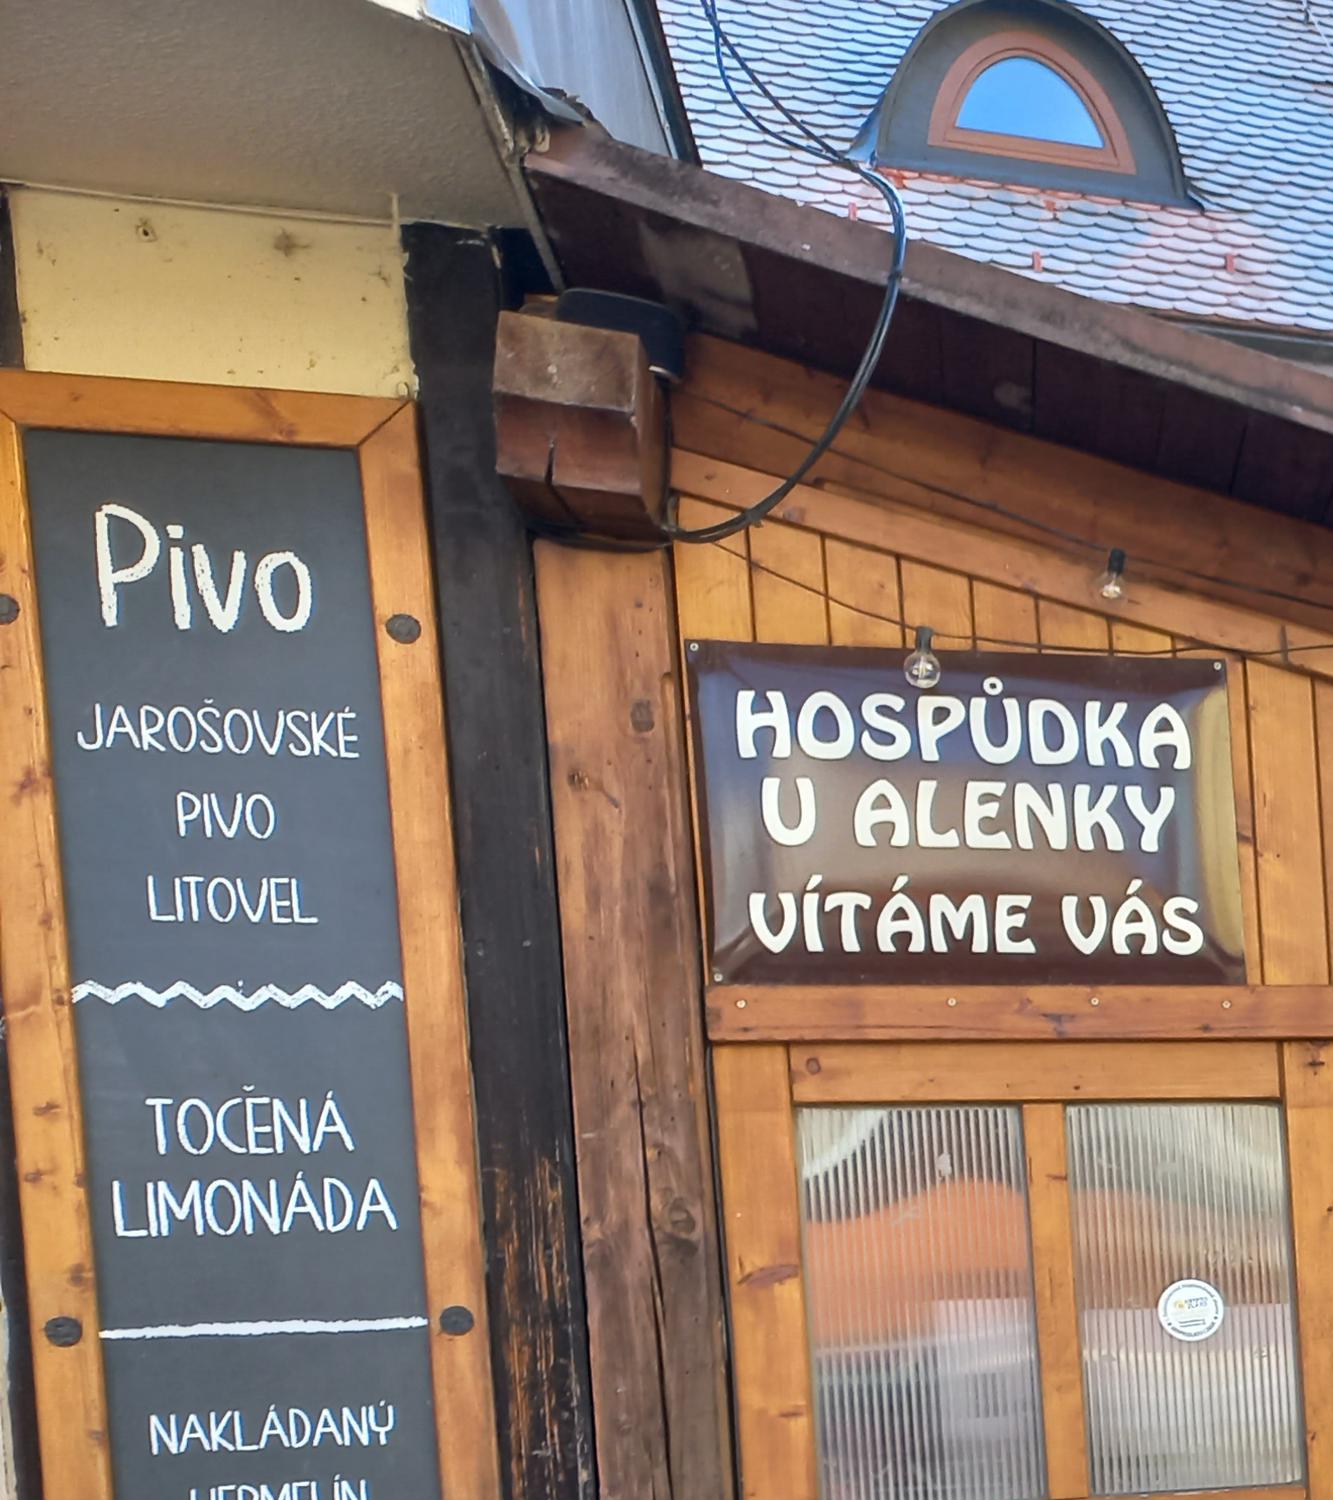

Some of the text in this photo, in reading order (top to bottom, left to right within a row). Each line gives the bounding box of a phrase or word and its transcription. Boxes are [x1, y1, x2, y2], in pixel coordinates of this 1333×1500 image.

[95, 503, 312, 632] Pivo
[77, 698, 360, 759] JAROŠOVSKÉ
[736, 676, 1192, 770] HOSPŮDKA
[176, 791, 275, 839] PIVO
[761, 777, 1176, 853] U ALENKY
[147, 874, 319, 924] LITOVEL
[748, 874, 1205, 957] VÍTÁME VÁS
[111, 1171, 398, 1238] LIMONÁDA
[149, 1401, 395, 1456] NAKLÁDANÝ
